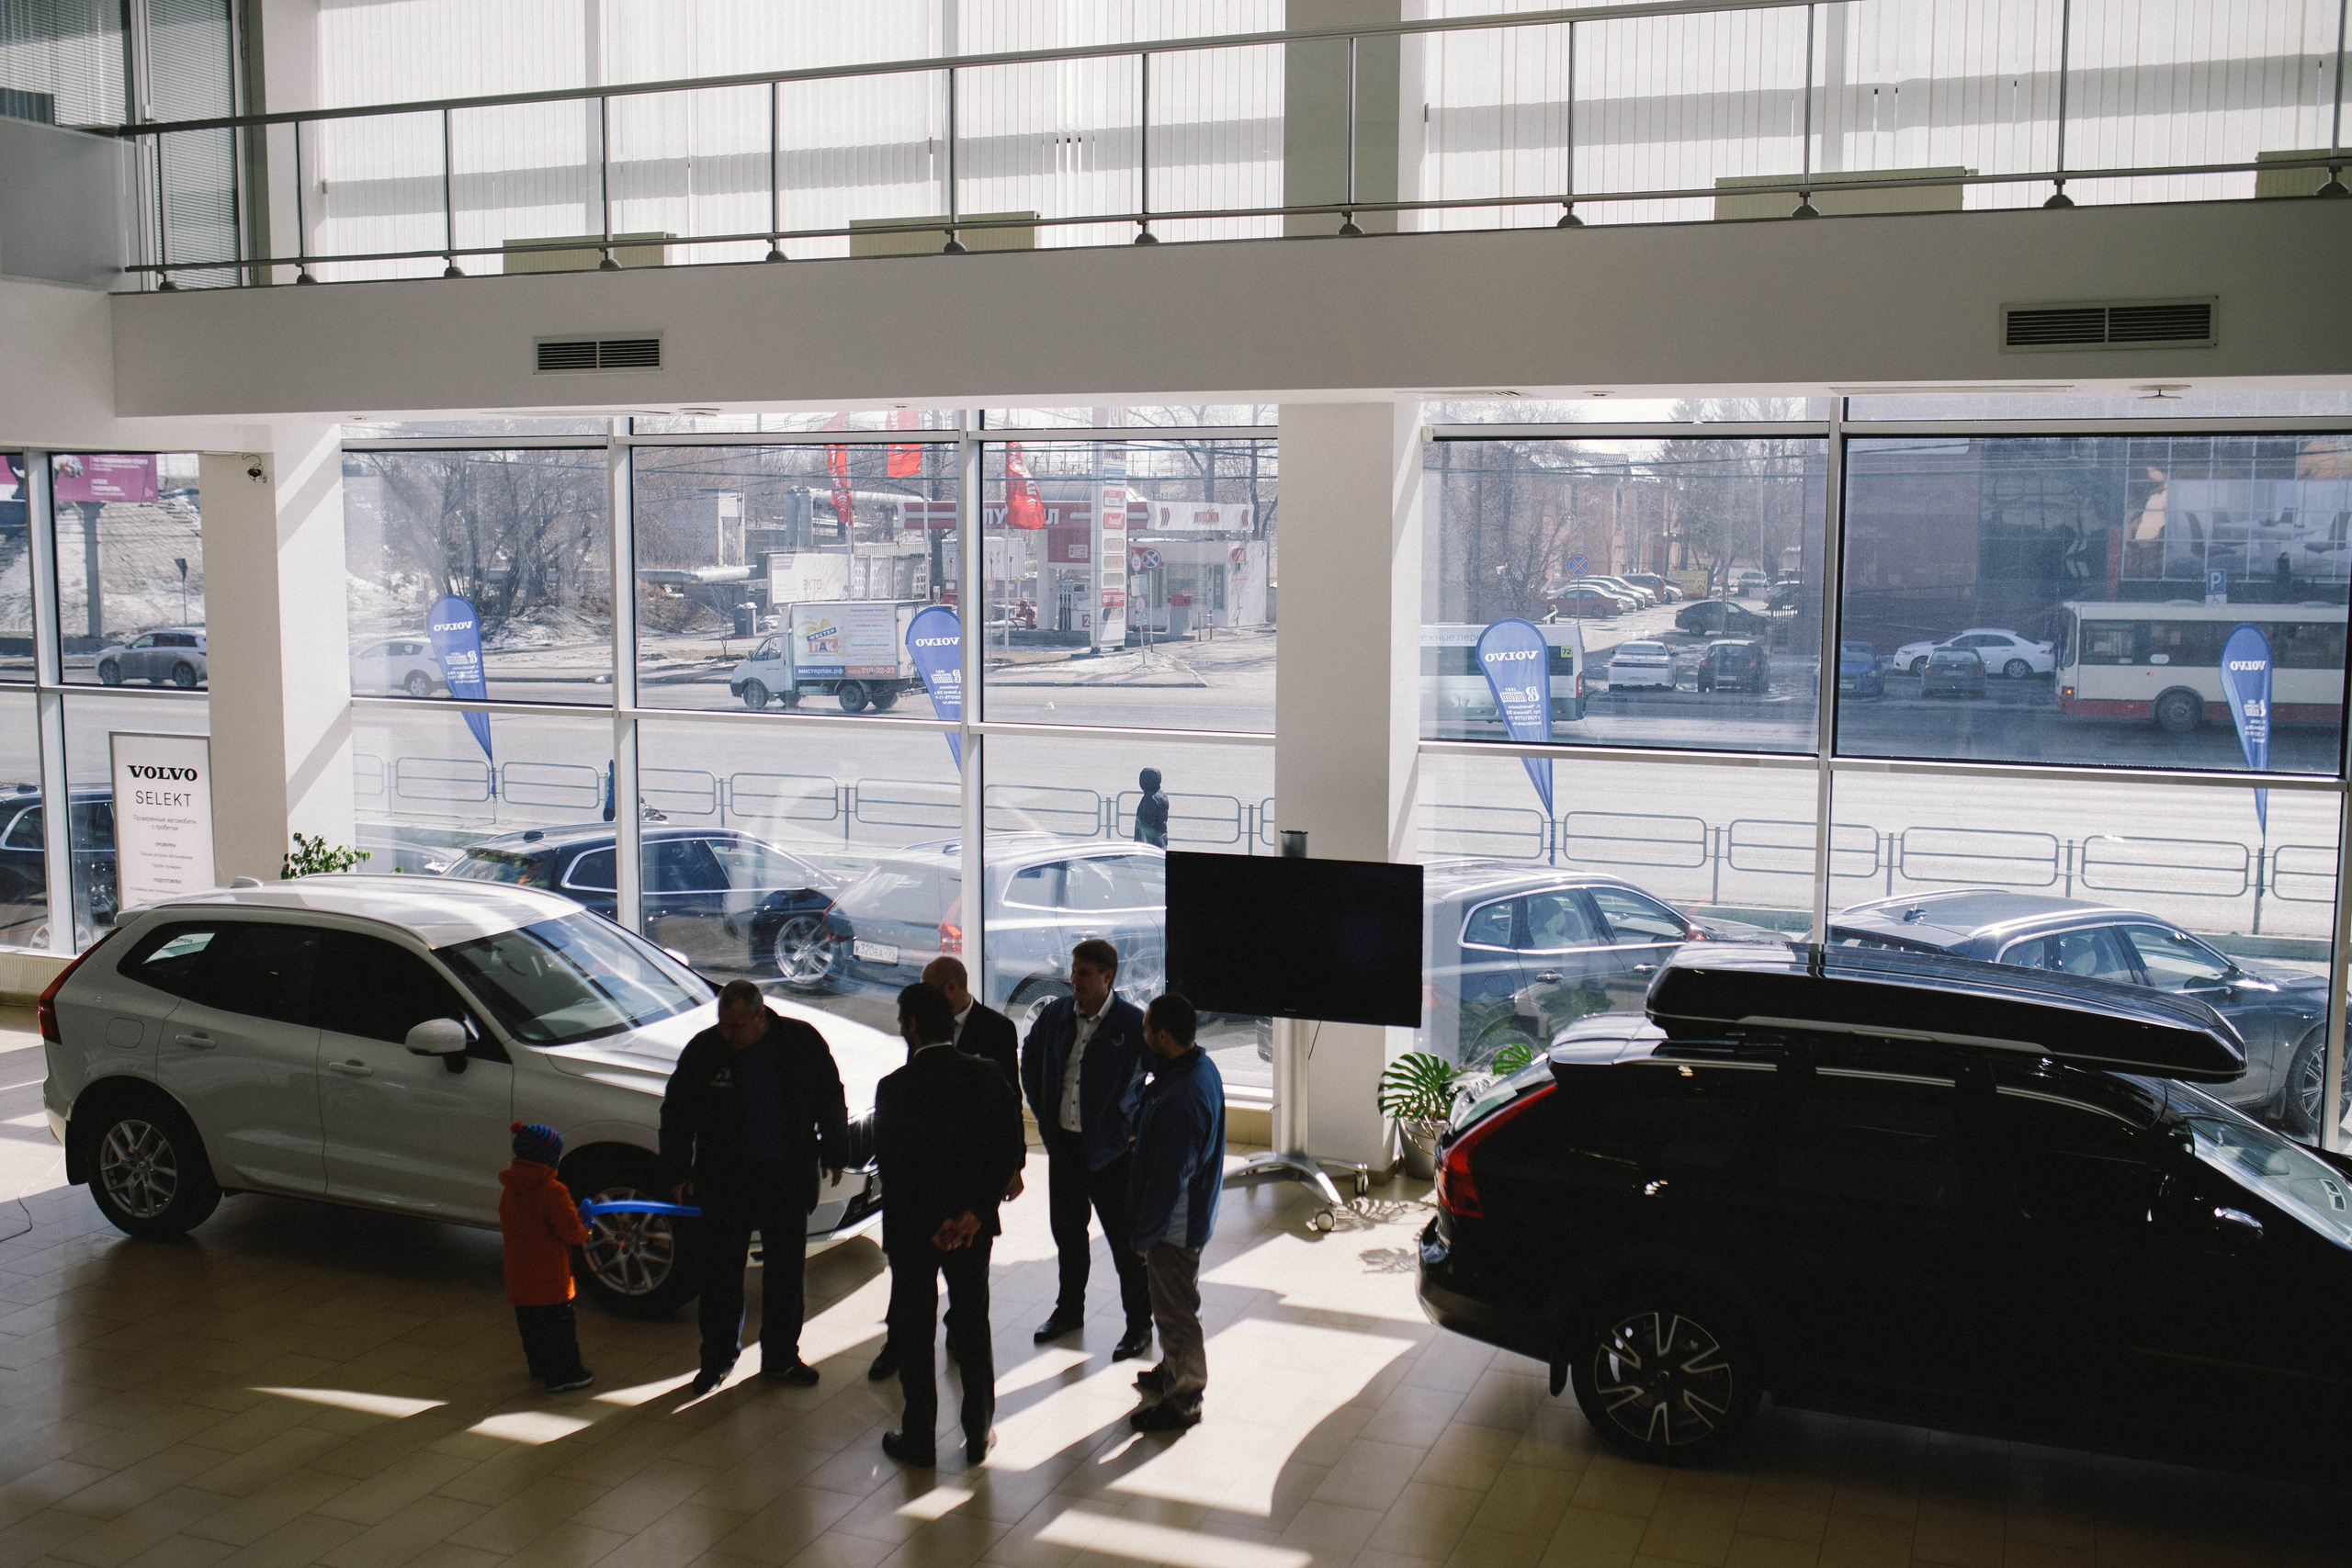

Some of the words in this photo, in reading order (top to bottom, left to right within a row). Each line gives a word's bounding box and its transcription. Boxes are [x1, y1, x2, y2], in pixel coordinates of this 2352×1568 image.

[984, 508, 1060, 525] ЛУЛ
[1133, 558, 1140, 567] 20
[803, 579, 822, 591] ЭКТО
[2211, 572, 2222, 591] P
[809, 627, 835, 640] МИСТЕР
[812, 641, 835, 652] ПАК
[128, 764, 198, 782] VOLVO
[135, 790, 192, 807] SELEKT
[132, 814, 166, 823] Проверенные
